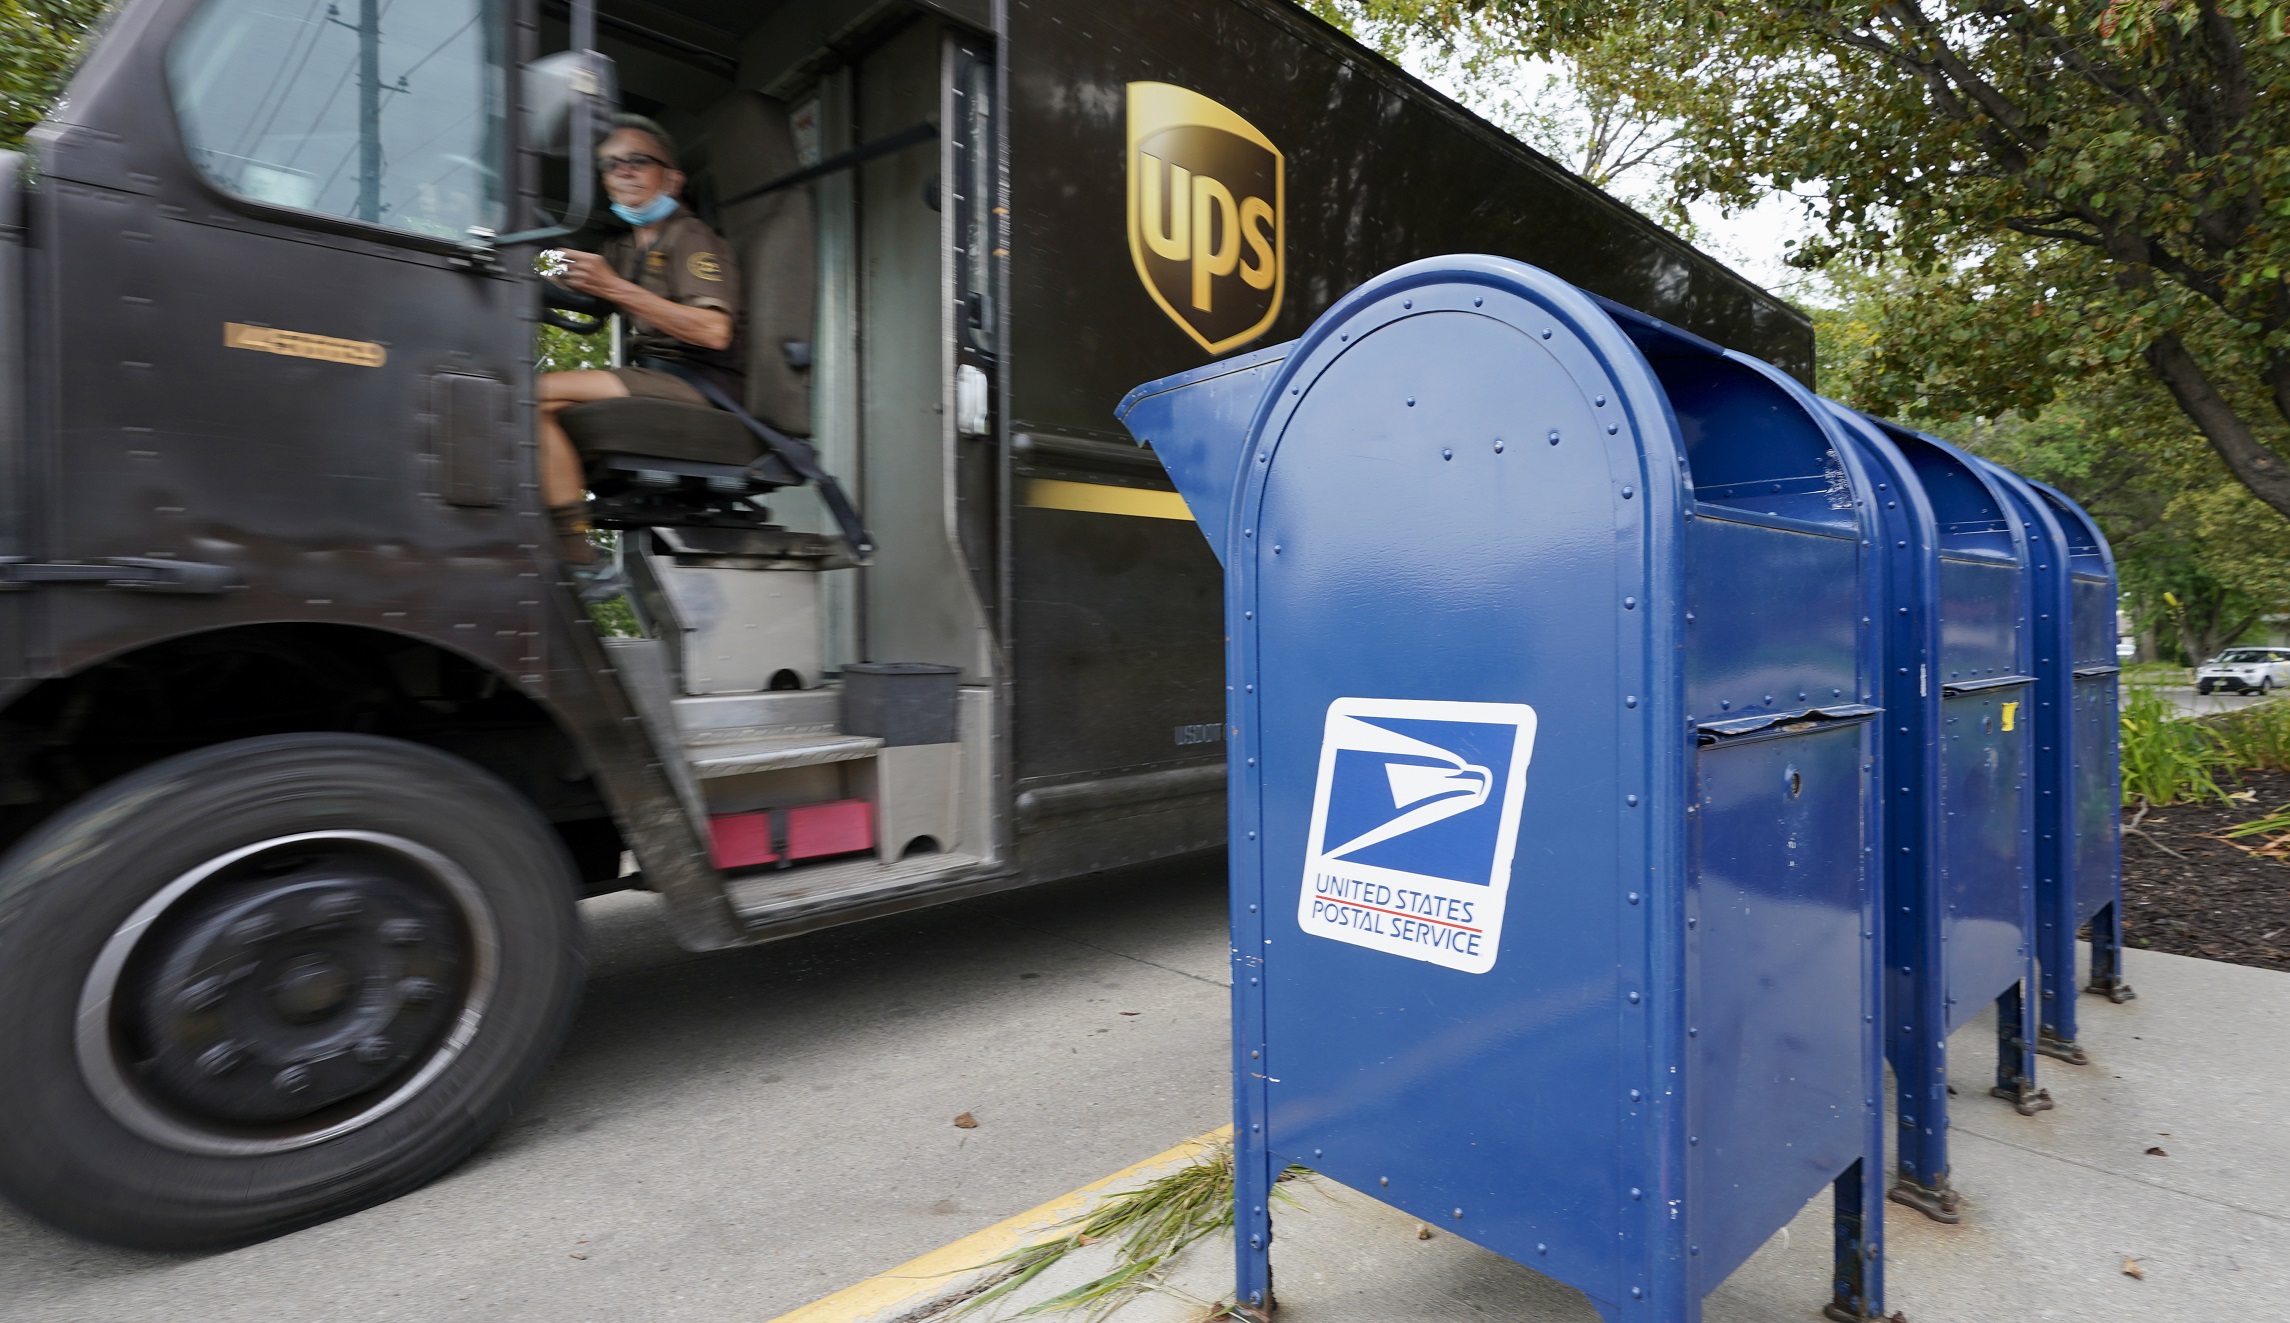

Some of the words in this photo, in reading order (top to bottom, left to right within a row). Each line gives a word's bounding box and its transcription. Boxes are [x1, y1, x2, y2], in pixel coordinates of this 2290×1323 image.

[1139, 150, 1276, 313] ups
[1315, 873, 1391, 906] UNITED
[1395, 889, 1475, 923] STATES
[1312, 900, 1384, 935] POSTAL
[1390, 917, 1482, 957] SERVICE
